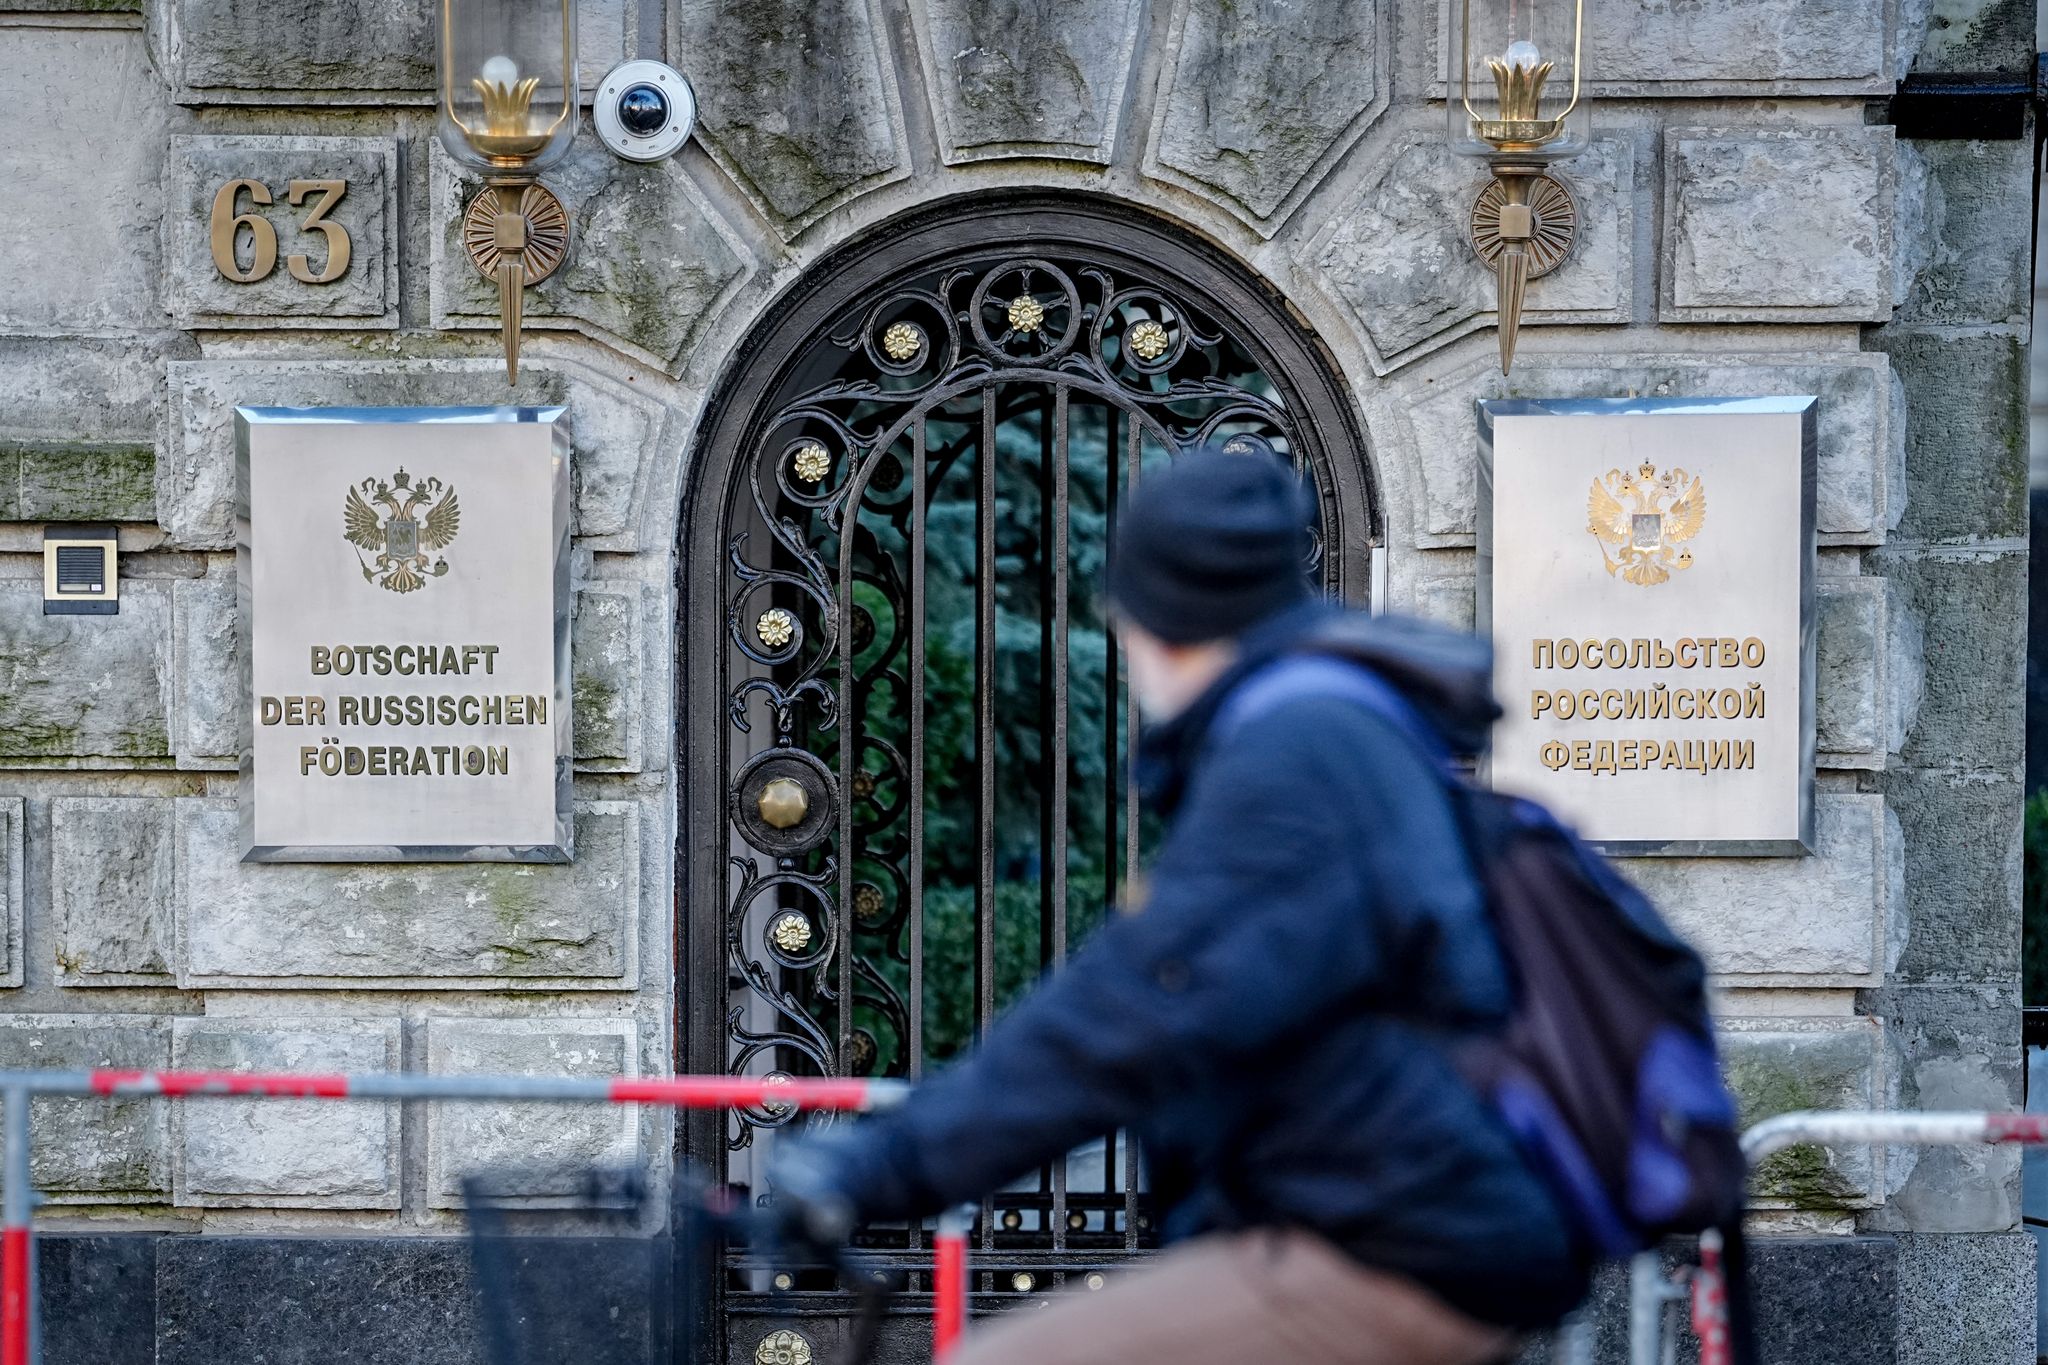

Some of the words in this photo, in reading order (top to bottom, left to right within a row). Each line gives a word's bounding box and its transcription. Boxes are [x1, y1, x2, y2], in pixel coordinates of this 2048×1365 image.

[210, 178, 351, 284] 63
[310, 644, 499, 676] BOTSCHAFT
[1531, 636, 1766, 669] ПОСОЛЬСТВО
[260, 695, 326, 726] DER
[338, 694, 547, 726] RUSSISCHEN
[1531, 681, 1766, 720] РОССИЙСКОЙ
[299, 736, 509, 776] FÖDERATION
[1539, 738, 1755, 776] ФЕДЕРАЦИИ
